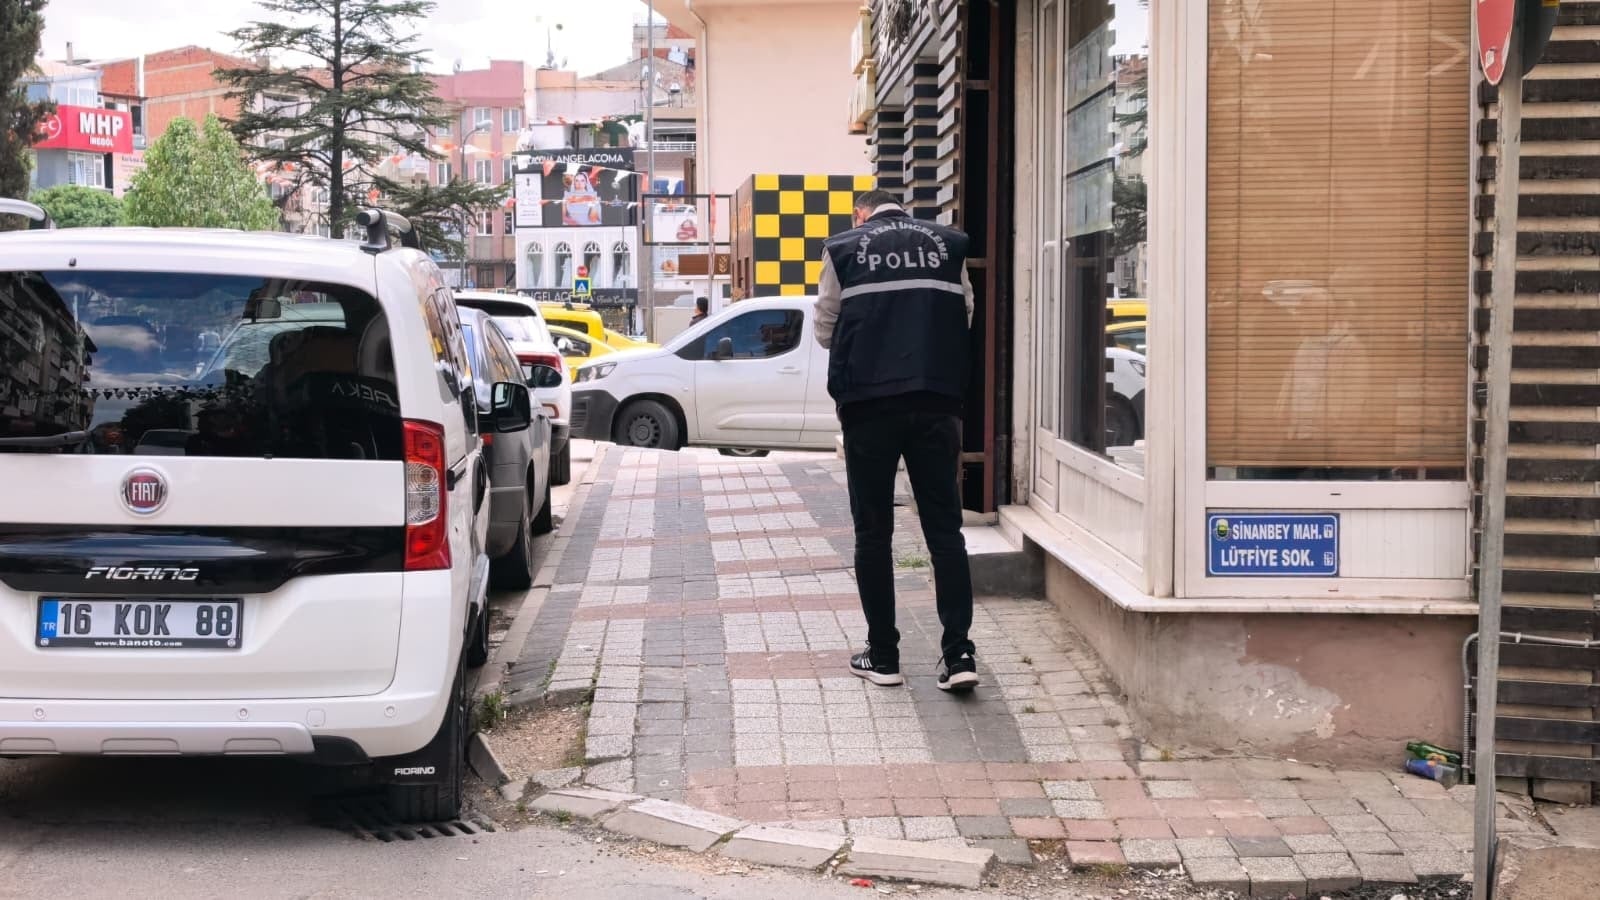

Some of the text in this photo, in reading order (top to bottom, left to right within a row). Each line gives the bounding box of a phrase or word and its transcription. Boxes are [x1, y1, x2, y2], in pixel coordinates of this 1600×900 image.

[79, 112, 124, 136] MHP
[556, 153, 624, 163] ANGELACOMA
[857, 234, 871, 264] OLAY
[868, 246, 941, 271] POLİS
[132, 482, 157, 502] FIAT
[1232, 521, 1322, 539] SİNANBEY MAH.
[1221, 545, 1314, 566] LÜTFİYE SOK.
[43, 603, 233, 636] TR 16 KOK 88
[94, 638, 183, 647] www.banoto.com
[394, 767, 435, 775] FIORINO
